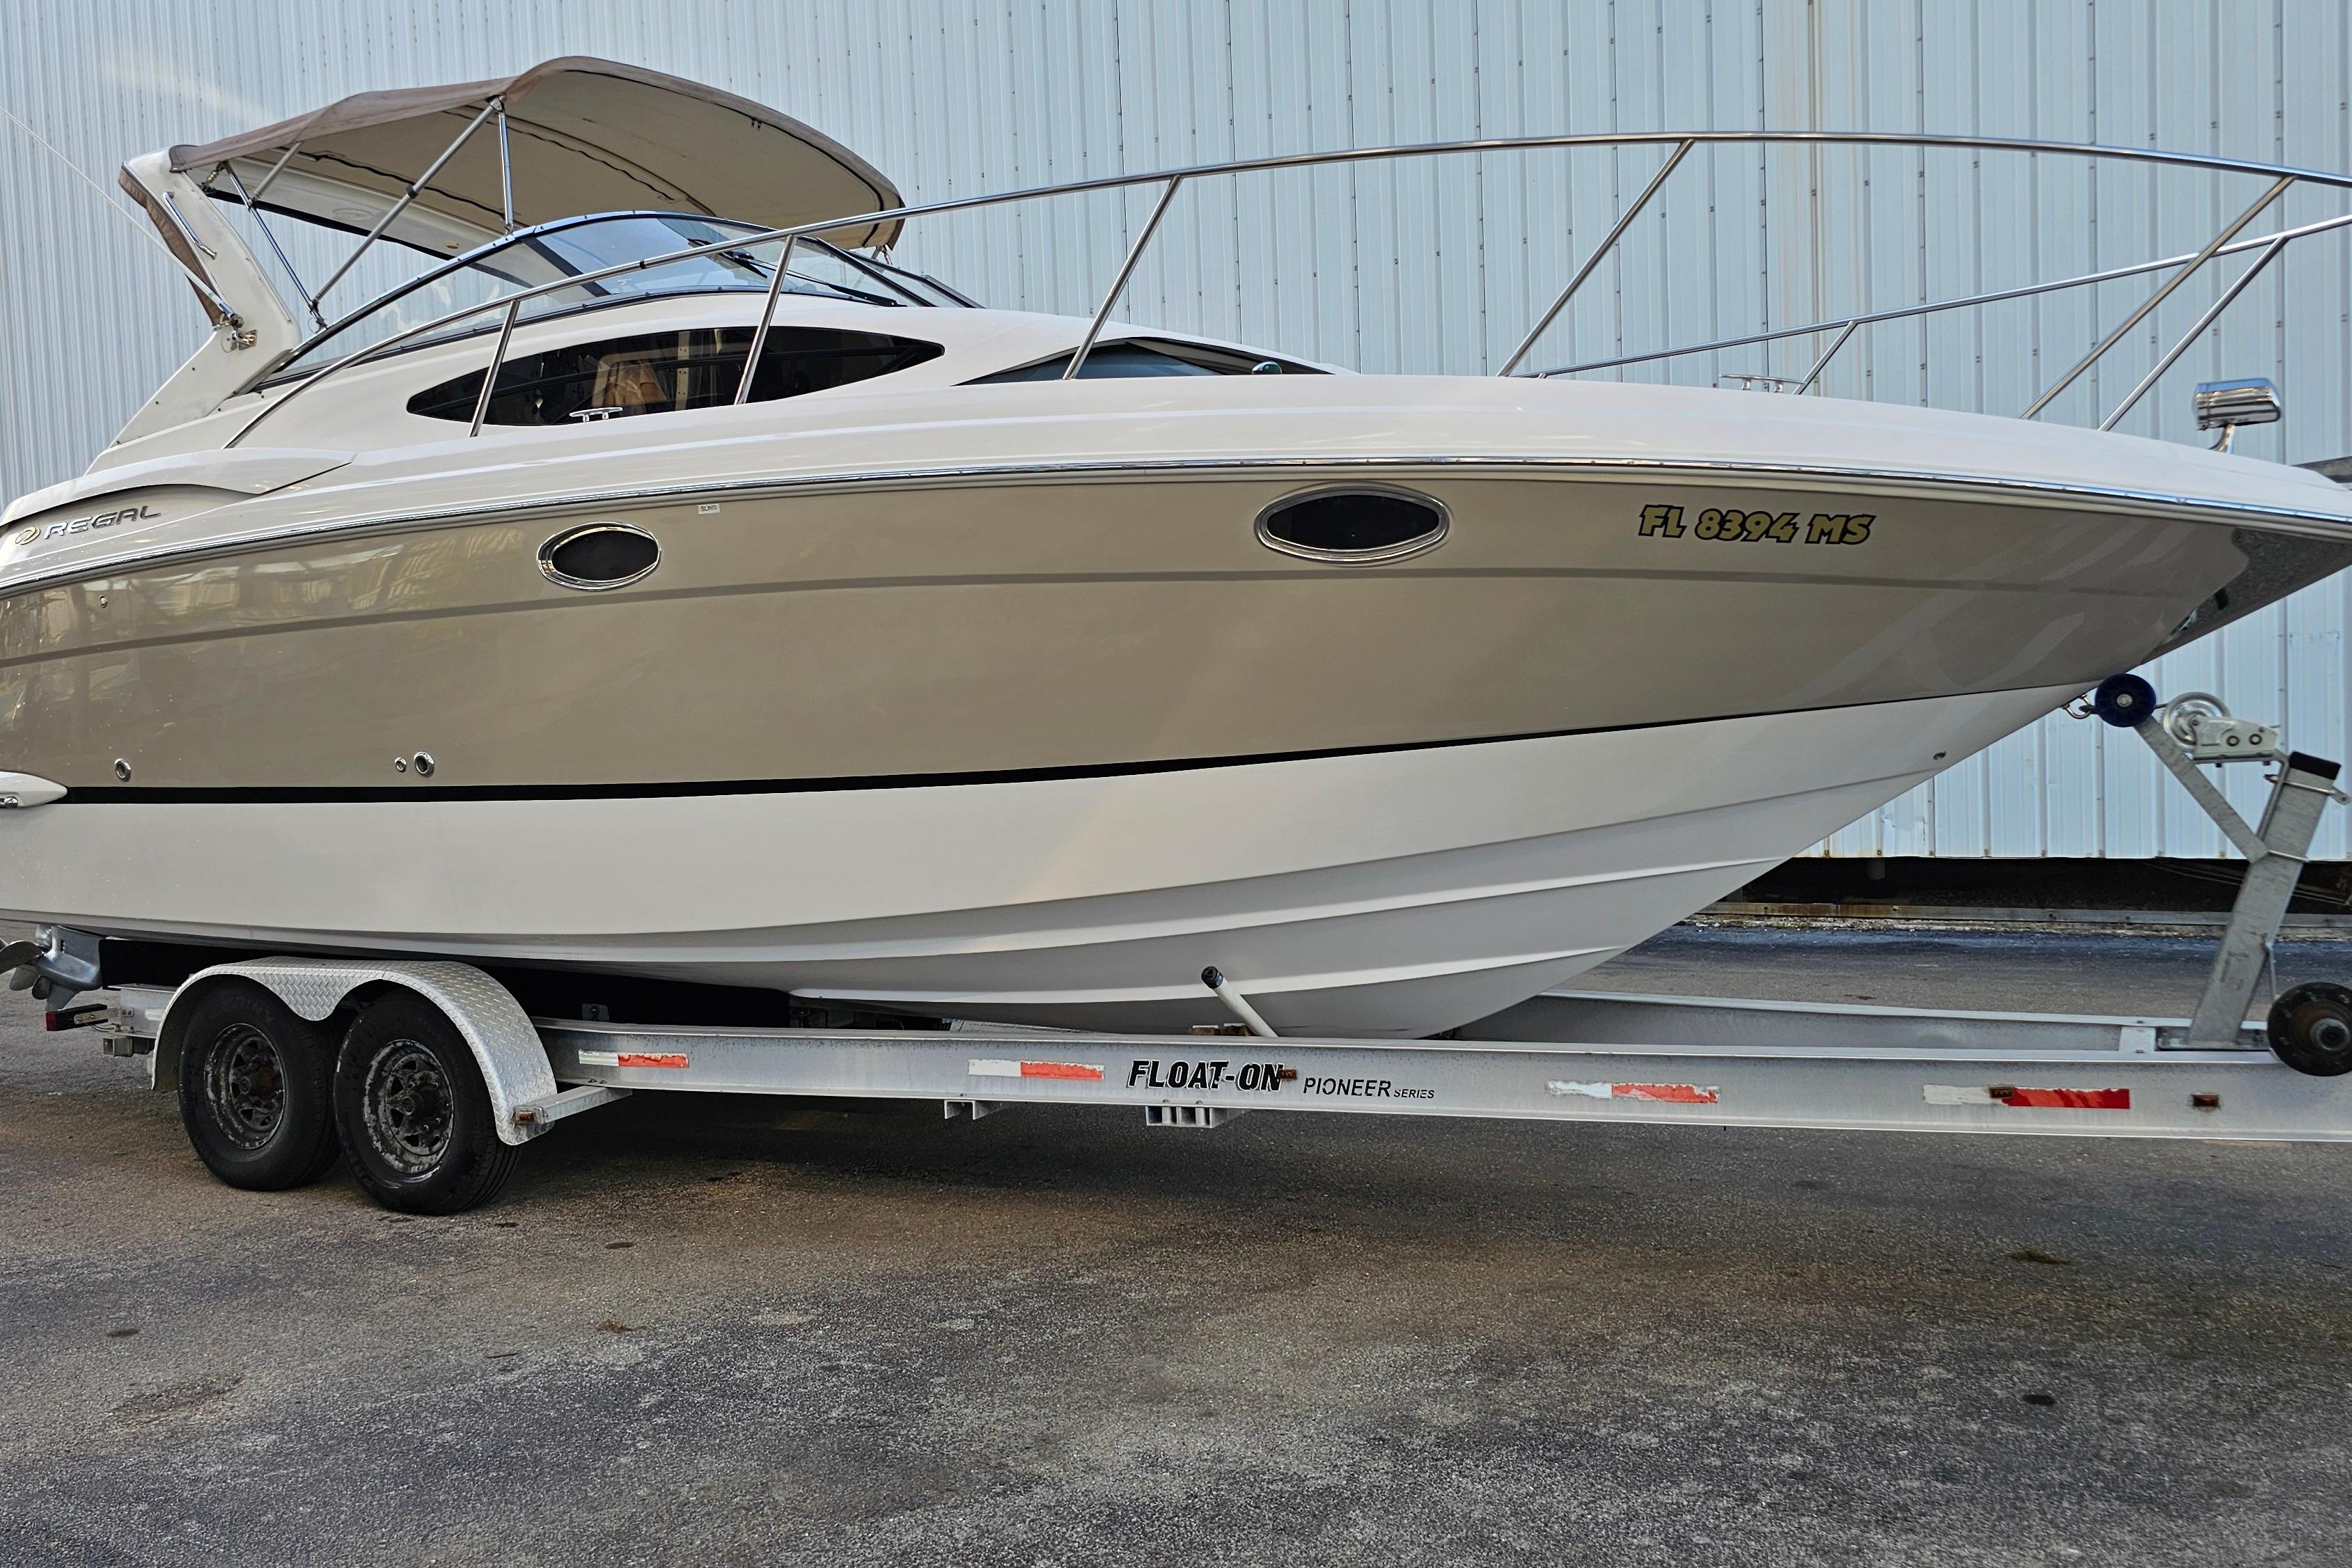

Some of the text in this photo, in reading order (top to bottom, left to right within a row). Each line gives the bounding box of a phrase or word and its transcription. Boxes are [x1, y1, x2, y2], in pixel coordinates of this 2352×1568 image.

[43, 505, 162, 540] REGAL
[1638, 504, 1876, 545] FL 8394 MS
[1127, 1059, 1435, 1099] FLOAT-ON PIONEER SERIES
